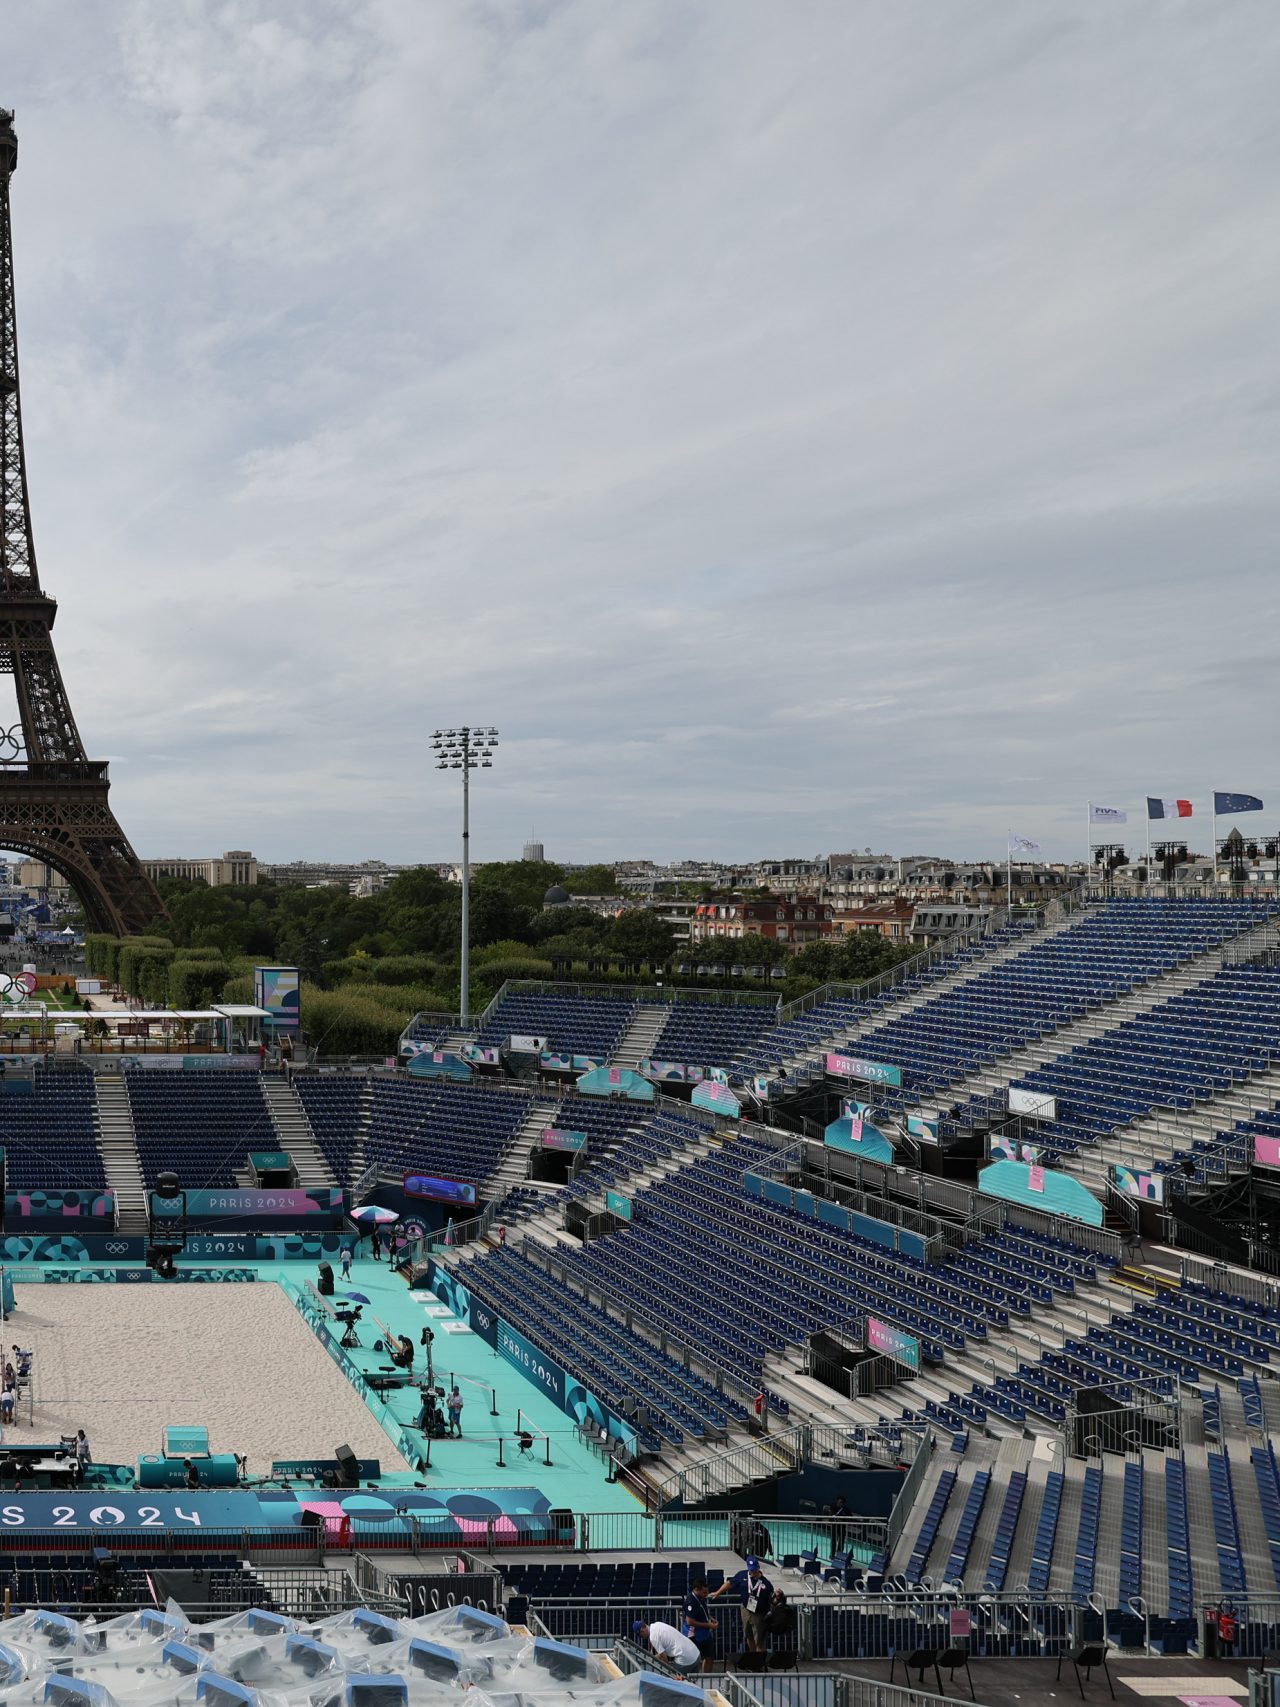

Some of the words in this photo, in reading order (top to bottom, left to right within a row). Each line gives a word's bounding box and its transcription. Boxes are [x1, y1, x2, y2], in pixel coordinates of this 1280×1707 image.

[257, 1198, 295, 1208] 2024
[205, 1242, 245, 1253] 2024
[532, 1359, 558, 1393] 2024
[51, 1506, 201, 1526] 2024
